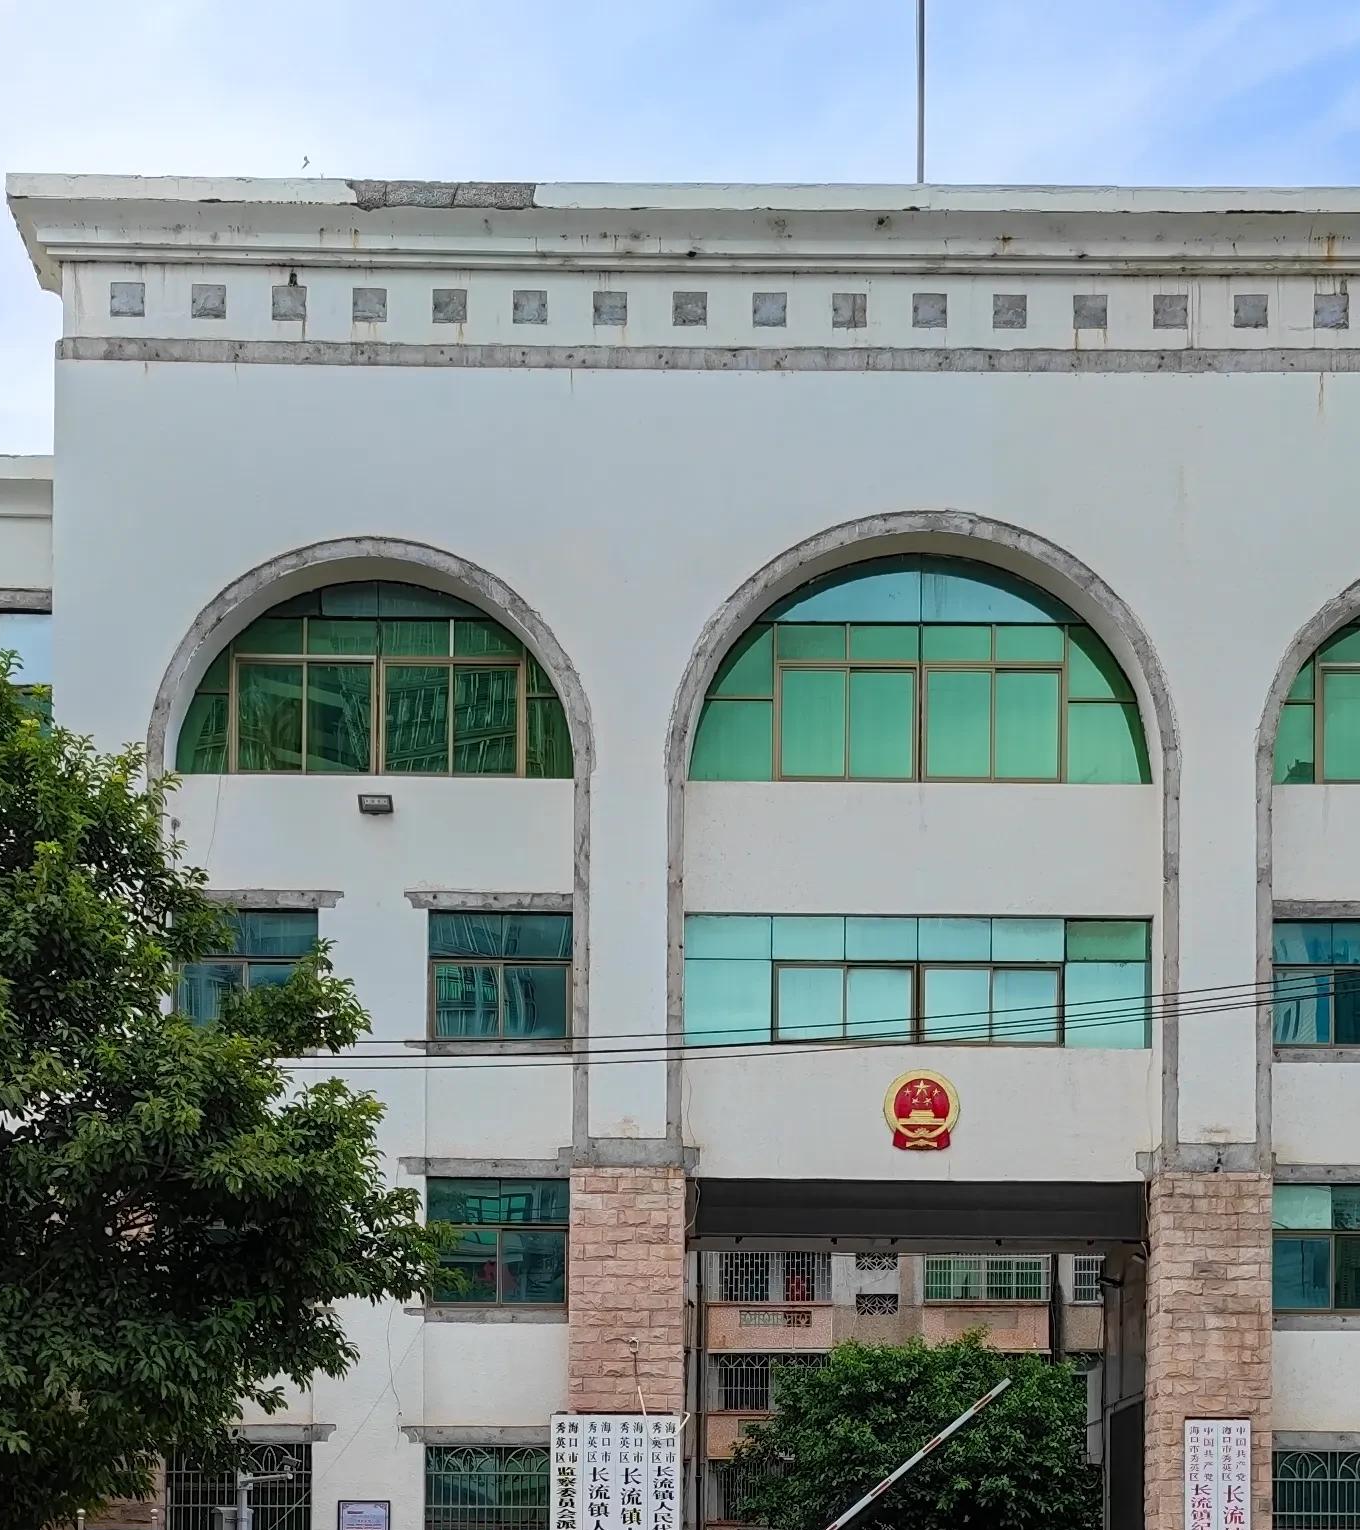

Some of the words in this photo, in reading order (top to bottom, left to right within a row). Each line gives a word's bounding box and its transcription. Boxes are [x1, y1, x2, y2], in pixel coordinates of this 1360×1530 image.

[555, 1421, 566, 1464] 秀英区
[568, 1421, 579, 1464] 海口市
[587, 1421, 598, 1464] 秀英区
[601, 1421, 612, 1464] 海口市
[619, 1421, 631, 1464] 秀英区
[633, 1421, 644, 1464] 海口市
[651, 1421, 663, 1464] 秀英区
[665, 1421, 676, 1464] 海口市
[1221, 1425, 1232, 1482] 海口市秀英区
[1235, 1425, 1247, 1483] 中国共产党
